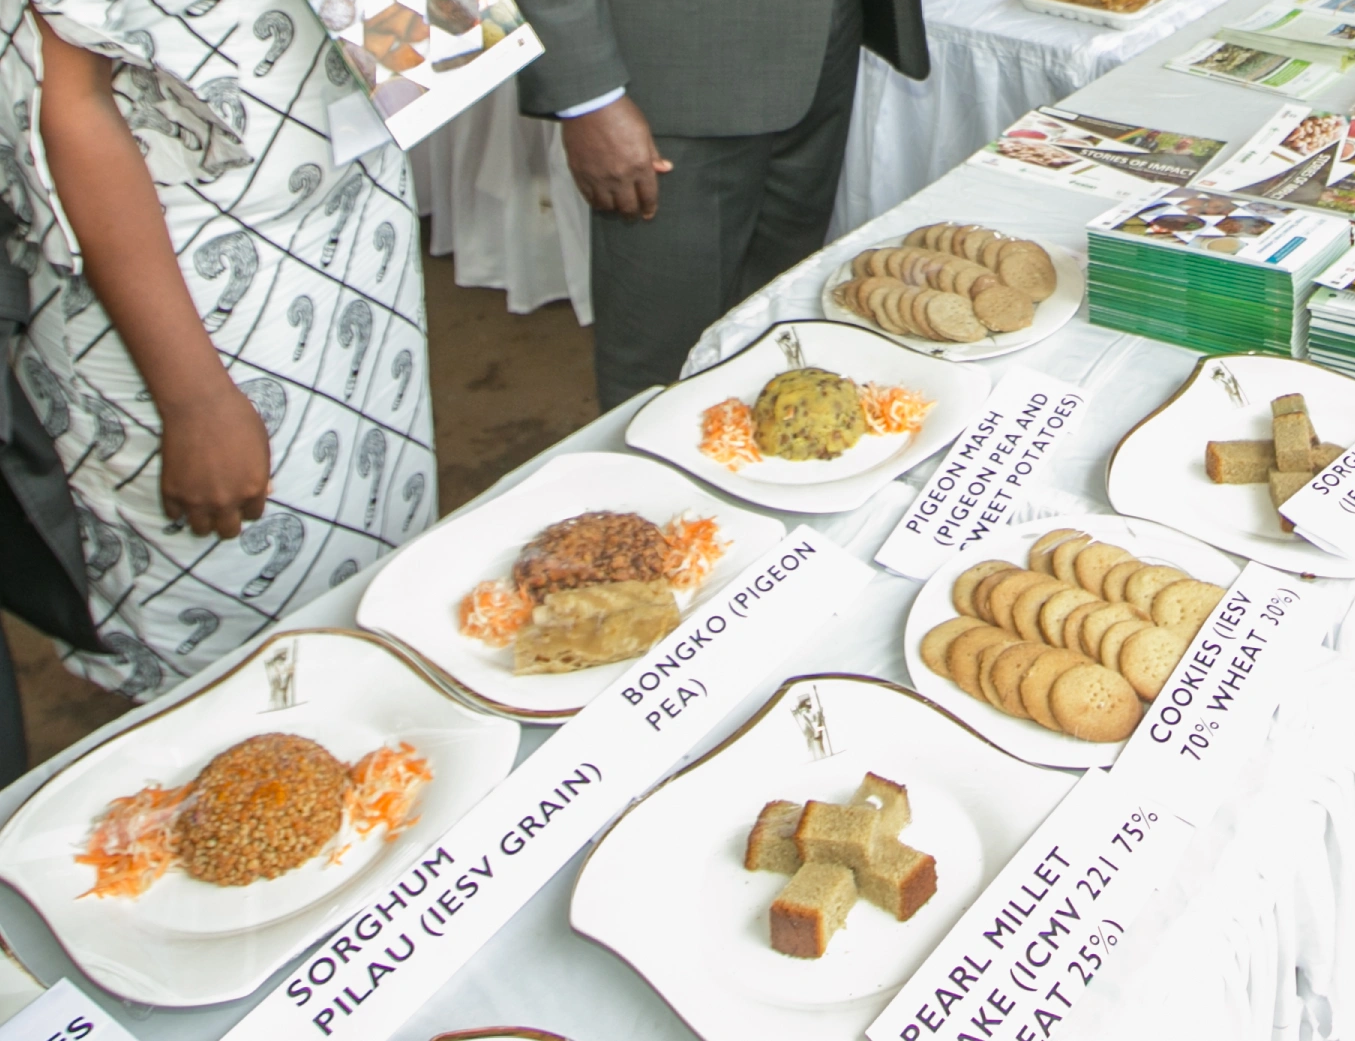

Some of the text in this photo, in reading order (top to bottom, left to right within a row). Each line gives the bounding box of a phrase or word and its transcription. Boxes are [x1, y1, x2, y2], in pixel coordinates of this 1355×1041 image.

[1081, 150, 1197, 177] STORIES OF IMPACT
[906, 411, 1004, 534] PIGEON MASH
[933, 393, 1048, 546] (PIGEON PEA AND
[959, 394, 1084, 551] WEET POTATOES)
[621, 541, 817, 706] BONGKO (PIGEON
[1150, 591, 1251, 743] COOKIES (IESV
[1180, 588, 1300, 760] 70% WHEAT 30%)
[645, 679, 708, 731] PEA)
[287, 847, 454, 1007] SORGHUM
[312, 763, 602, 1036] PILAU (IESV GRAIN)
[900, 846, 1069, 1041] PEARL MILLET
[1010, 897, 1081, 991] (ICMV
[1076, 856, 1119, 900] 221
[1111, 806, 1158, 852] 75%
[1068, 919, 1124, 986] 25%)
